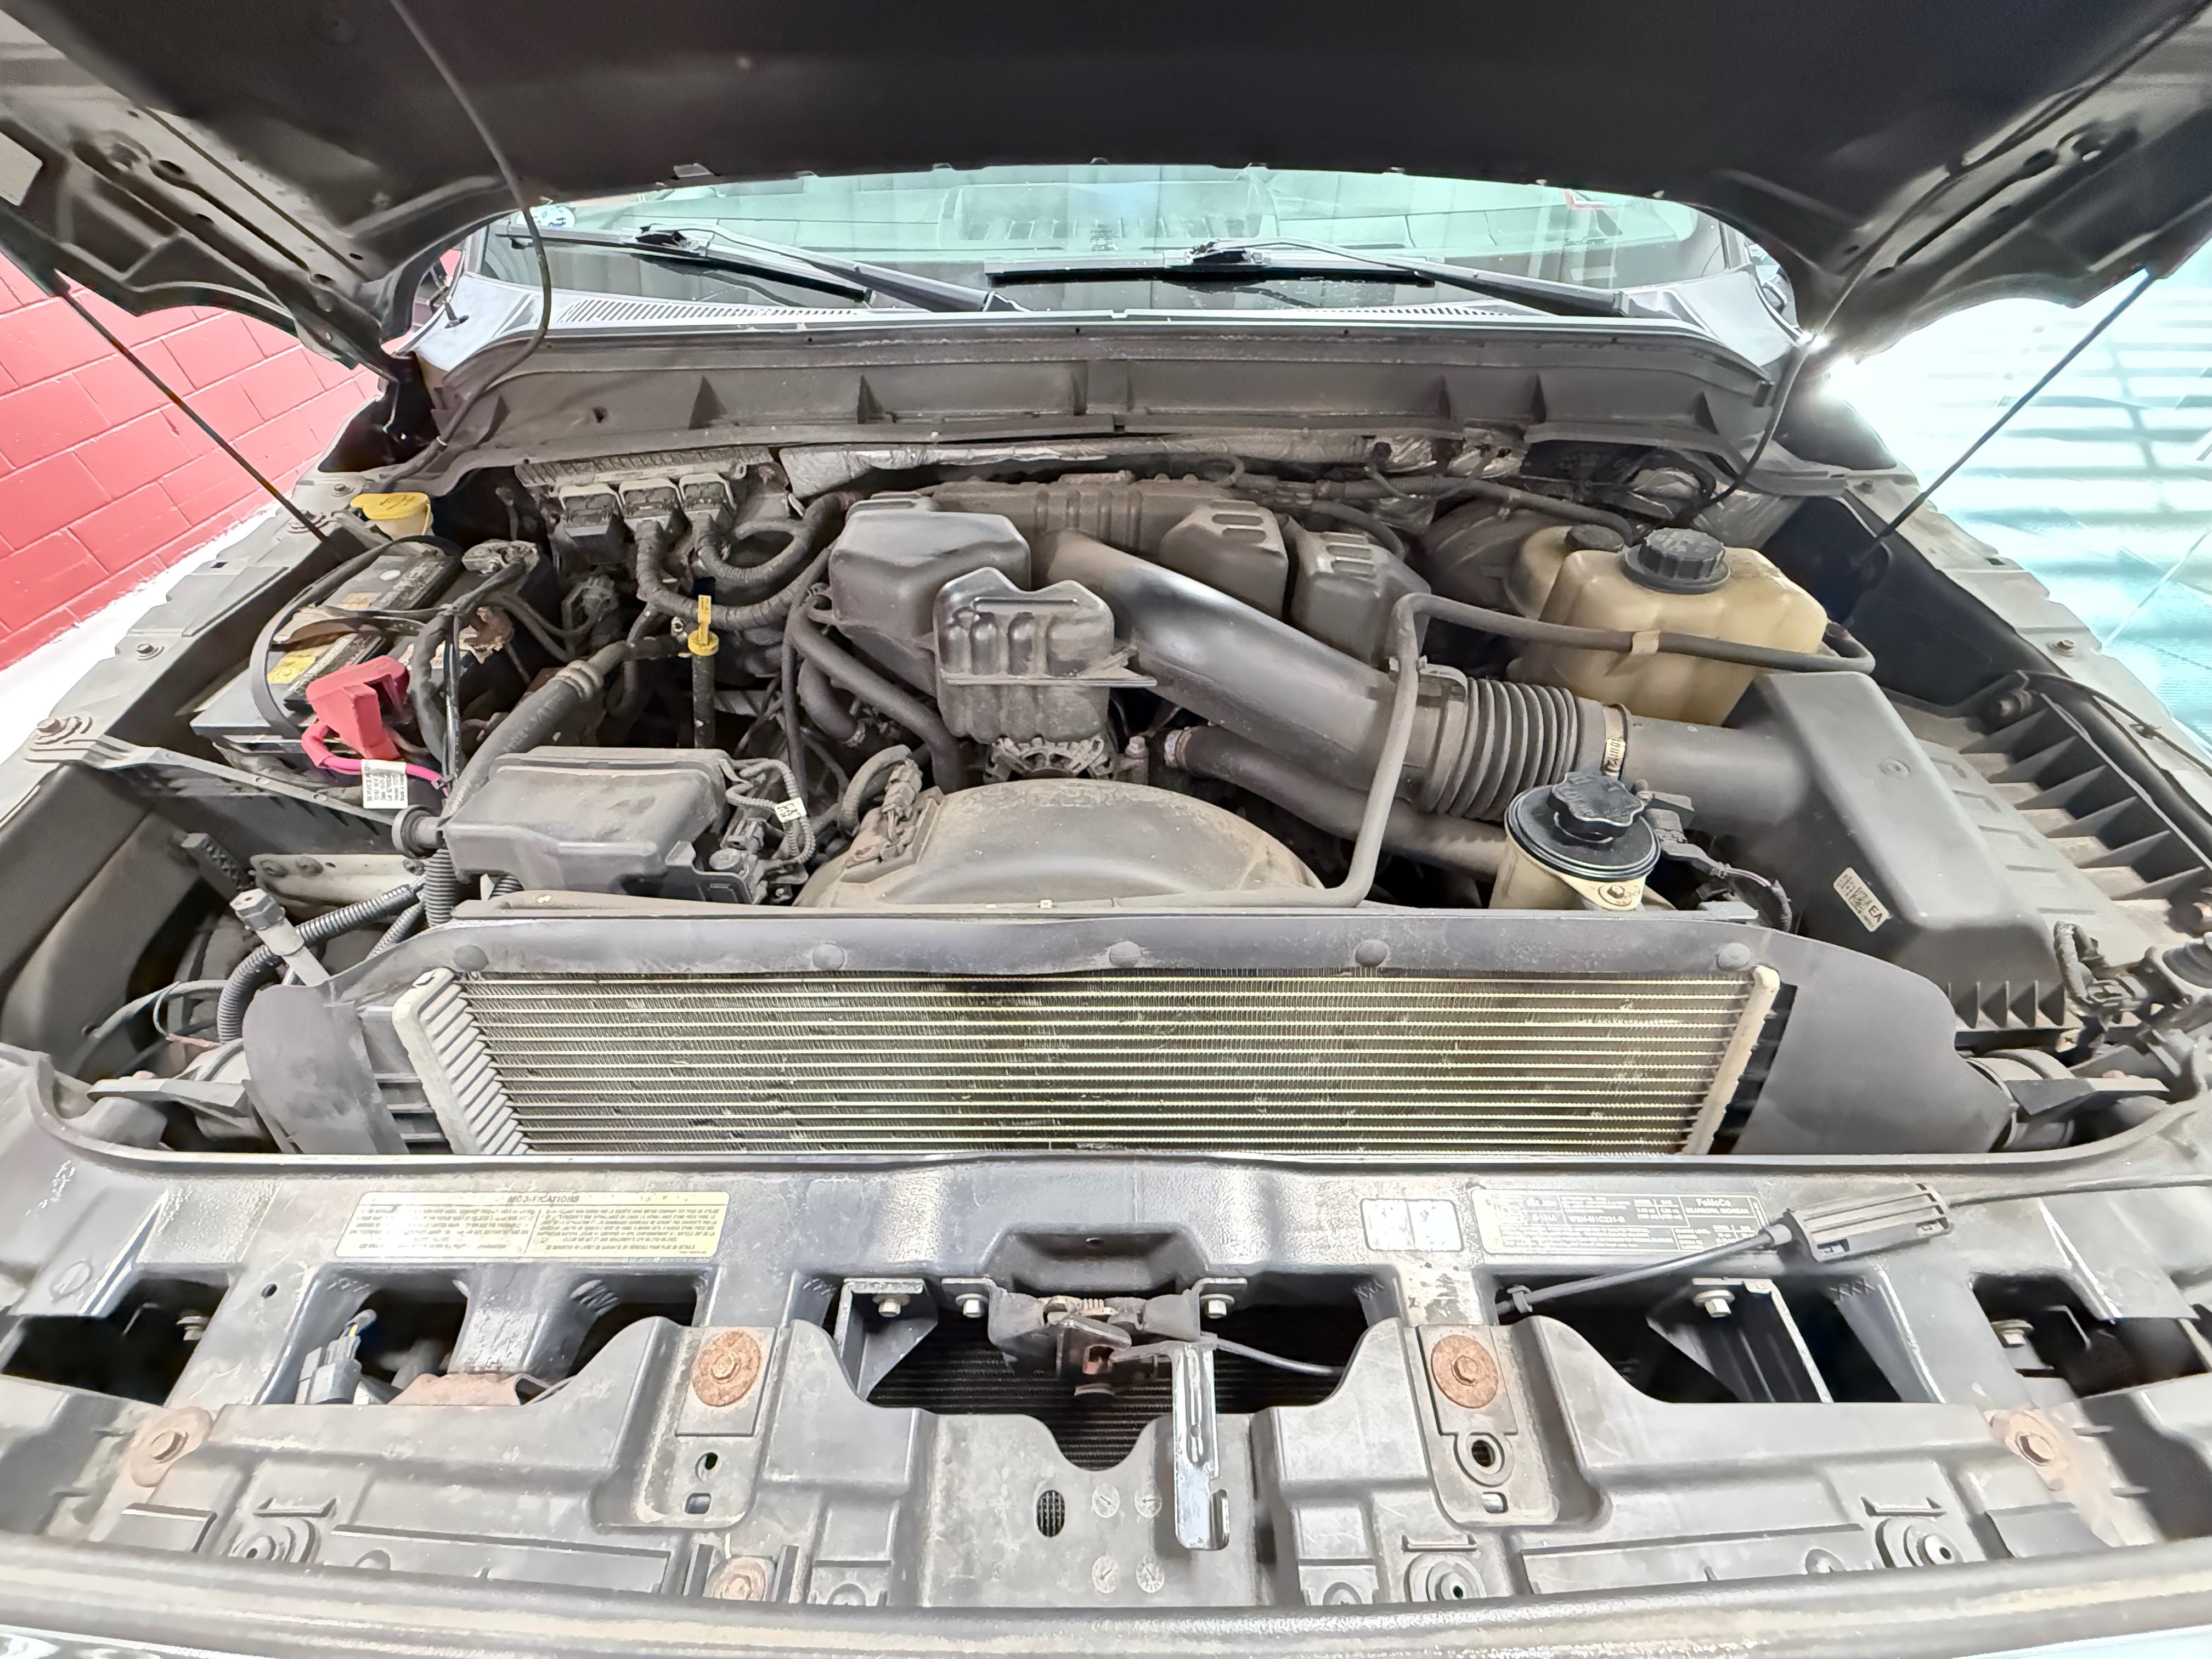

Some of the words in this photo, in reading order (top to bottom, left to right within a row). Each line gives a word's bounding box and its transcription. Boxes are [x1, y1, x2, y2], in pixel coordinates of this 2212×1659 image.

[1868, 905, 1883, 923] EA
[507, 1195, 580, 1204] MODIFICATIONS
[1696, 1198, 1731, 1207] FoMoCo
